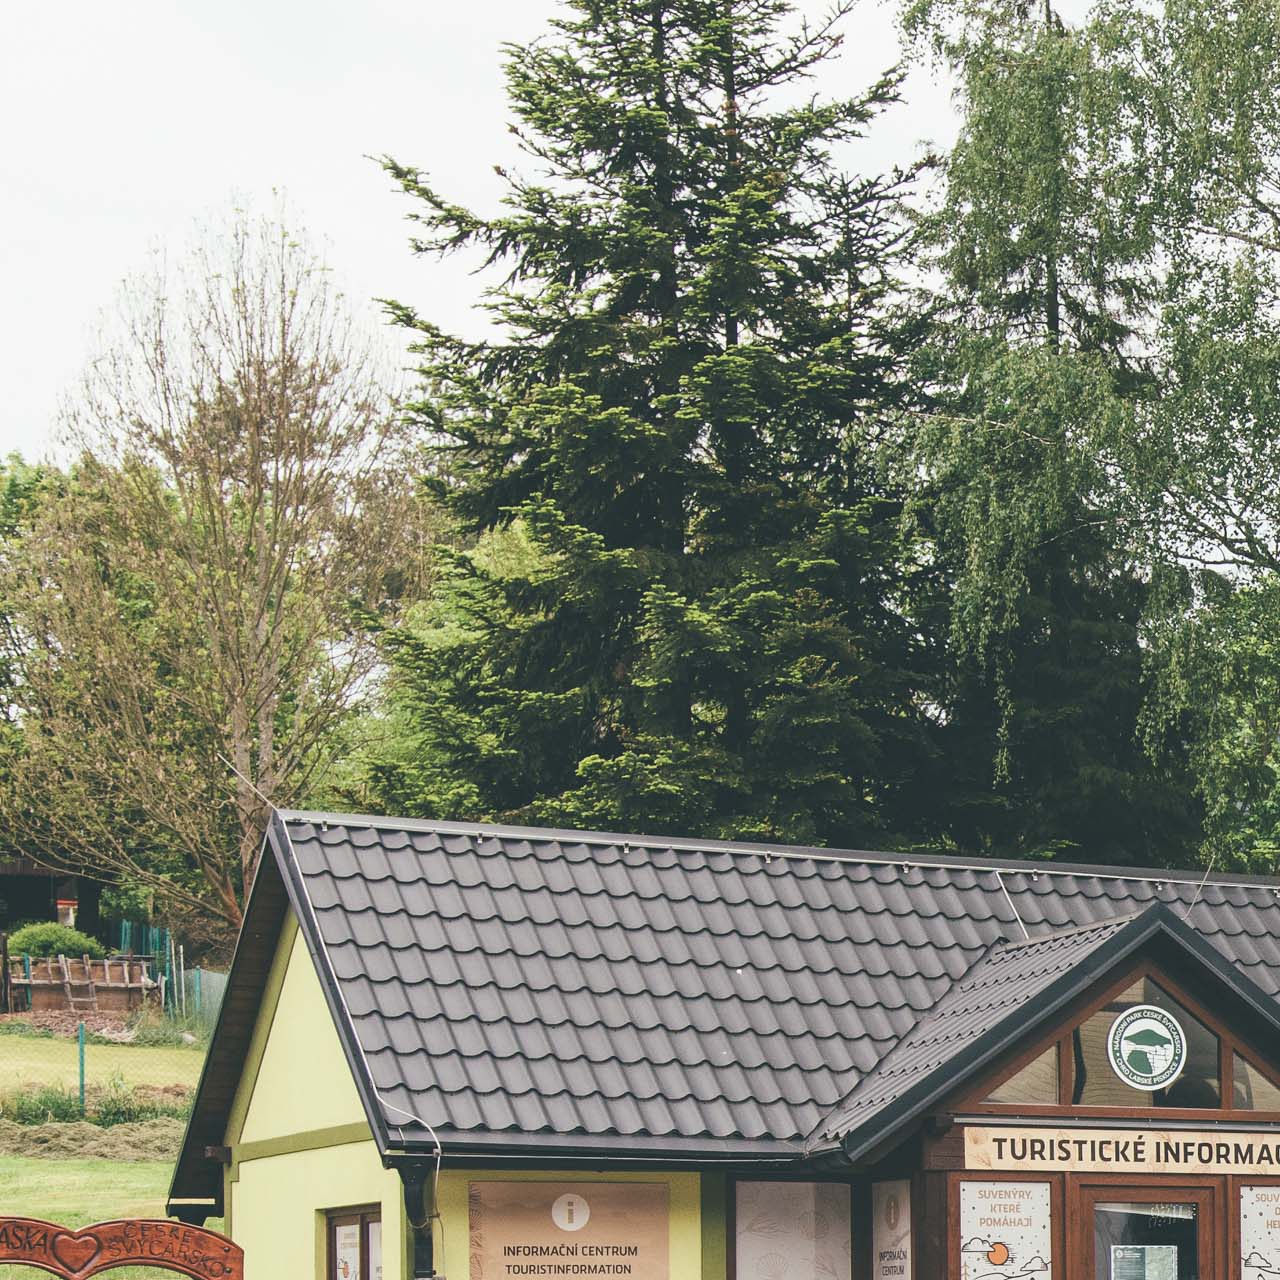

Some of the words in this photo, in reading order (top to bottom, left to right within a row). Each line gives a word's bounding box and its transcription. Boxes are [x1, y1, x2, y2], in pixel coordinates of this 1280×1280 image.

[1113, 1020, 1128, 1051] NÁRODNÍ
[1126, 1011, 1143, 1023] PARK
[1142, 1010, 1163, 1021] ČESKÉ
[1116, 1057, 1130, 1075] CHKO
[992, 1135, 1146, 1164] TURISTICKÉ
[990, 1202, 1021, 1214] KTERÉ
[979, 1215, 1032, 1227] POMÁHAJÍ
[503, 1242, 578, 1257] INFORMAČNÍ
[581, 1245, 638, 1257] CENTRUM
[505, 1264, 632, 1275] TOURISTINFORMATION
[881, 1265, 905, 1276] CENTRUM
